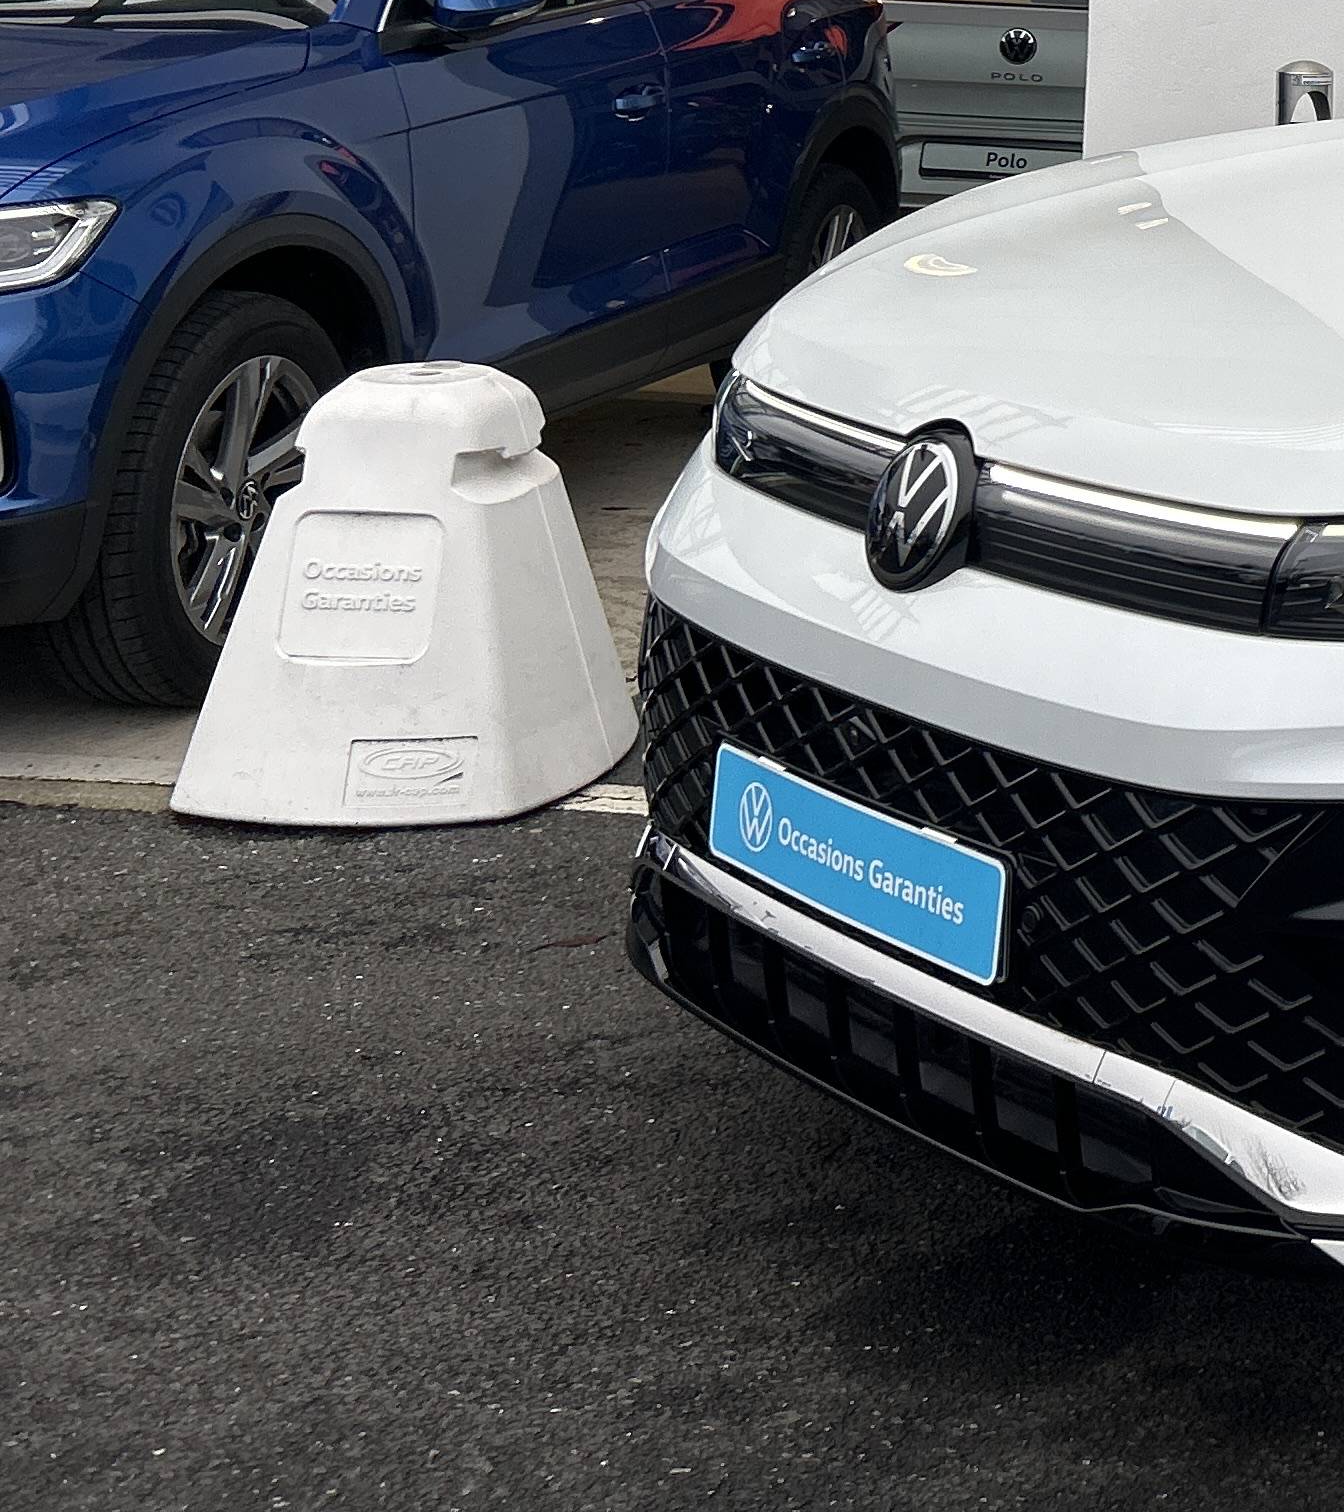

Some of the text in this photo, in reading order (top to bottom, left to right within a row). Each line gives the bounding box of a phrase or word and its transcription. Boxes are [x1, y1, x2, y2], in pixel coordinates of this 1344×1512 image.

[990, 71, 1044, 83] POLO
[986, 151, 1028, 169] Polo
[302, 560, 423, 583] Occasions
[301, 589, 417, 613] Garanties
[777, 817, 865, 882] Occasions
[868, 858, 965, 926] Garanties
